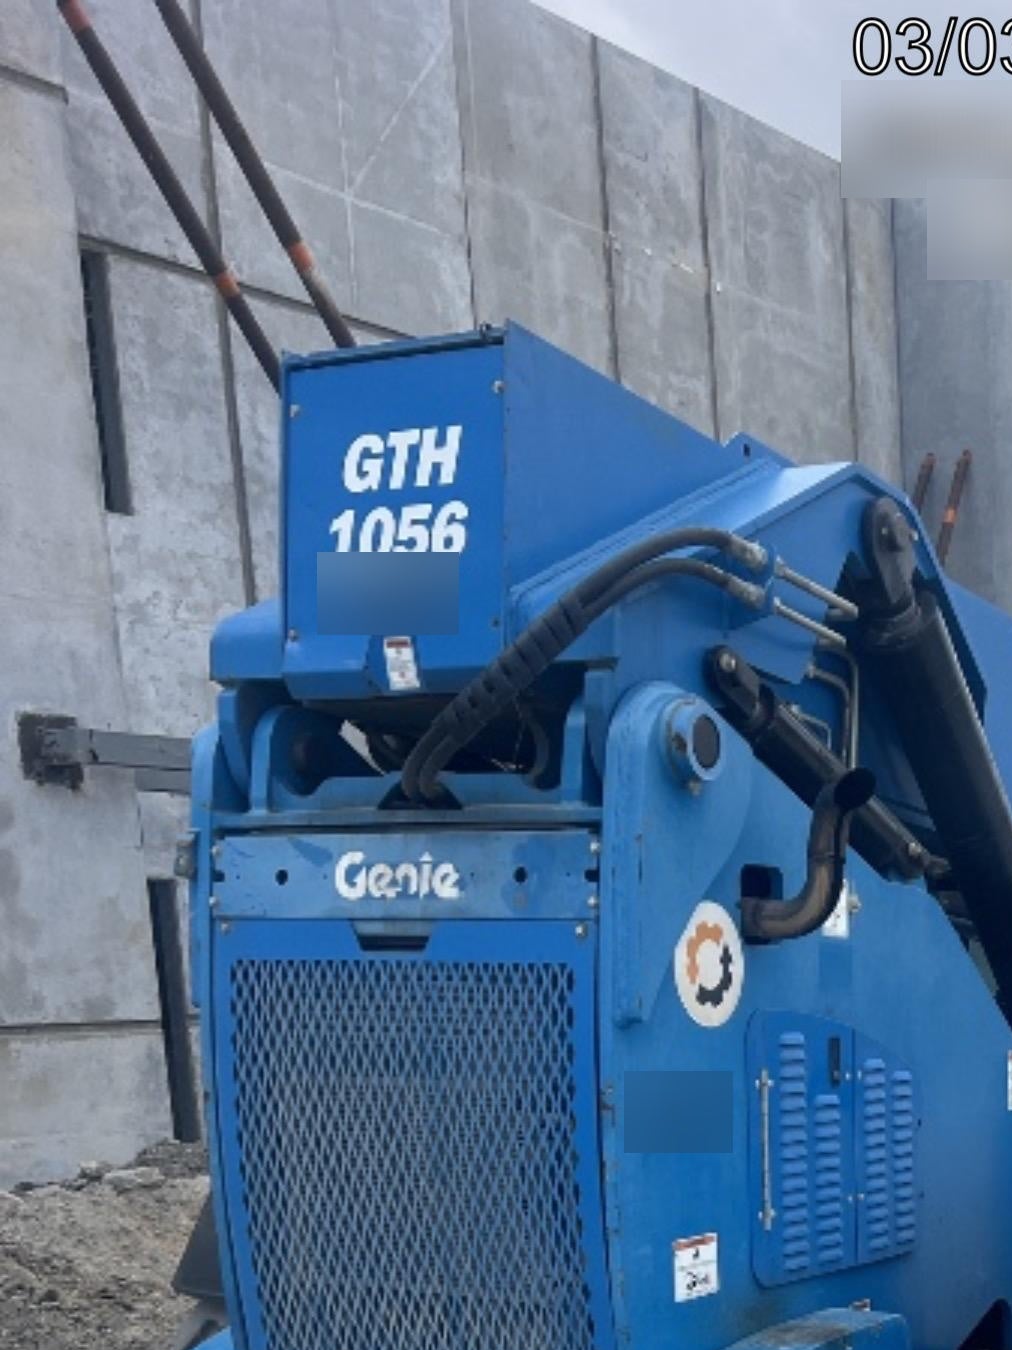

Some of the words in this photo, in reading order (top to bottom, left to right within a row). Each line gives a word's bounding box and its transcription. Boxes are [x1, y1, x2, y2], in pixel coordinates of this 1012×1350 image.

[343, 424, 462, 493] GTH
[329, 500, 469, 555] 1056
[335, 851, 460, 900] Genie
